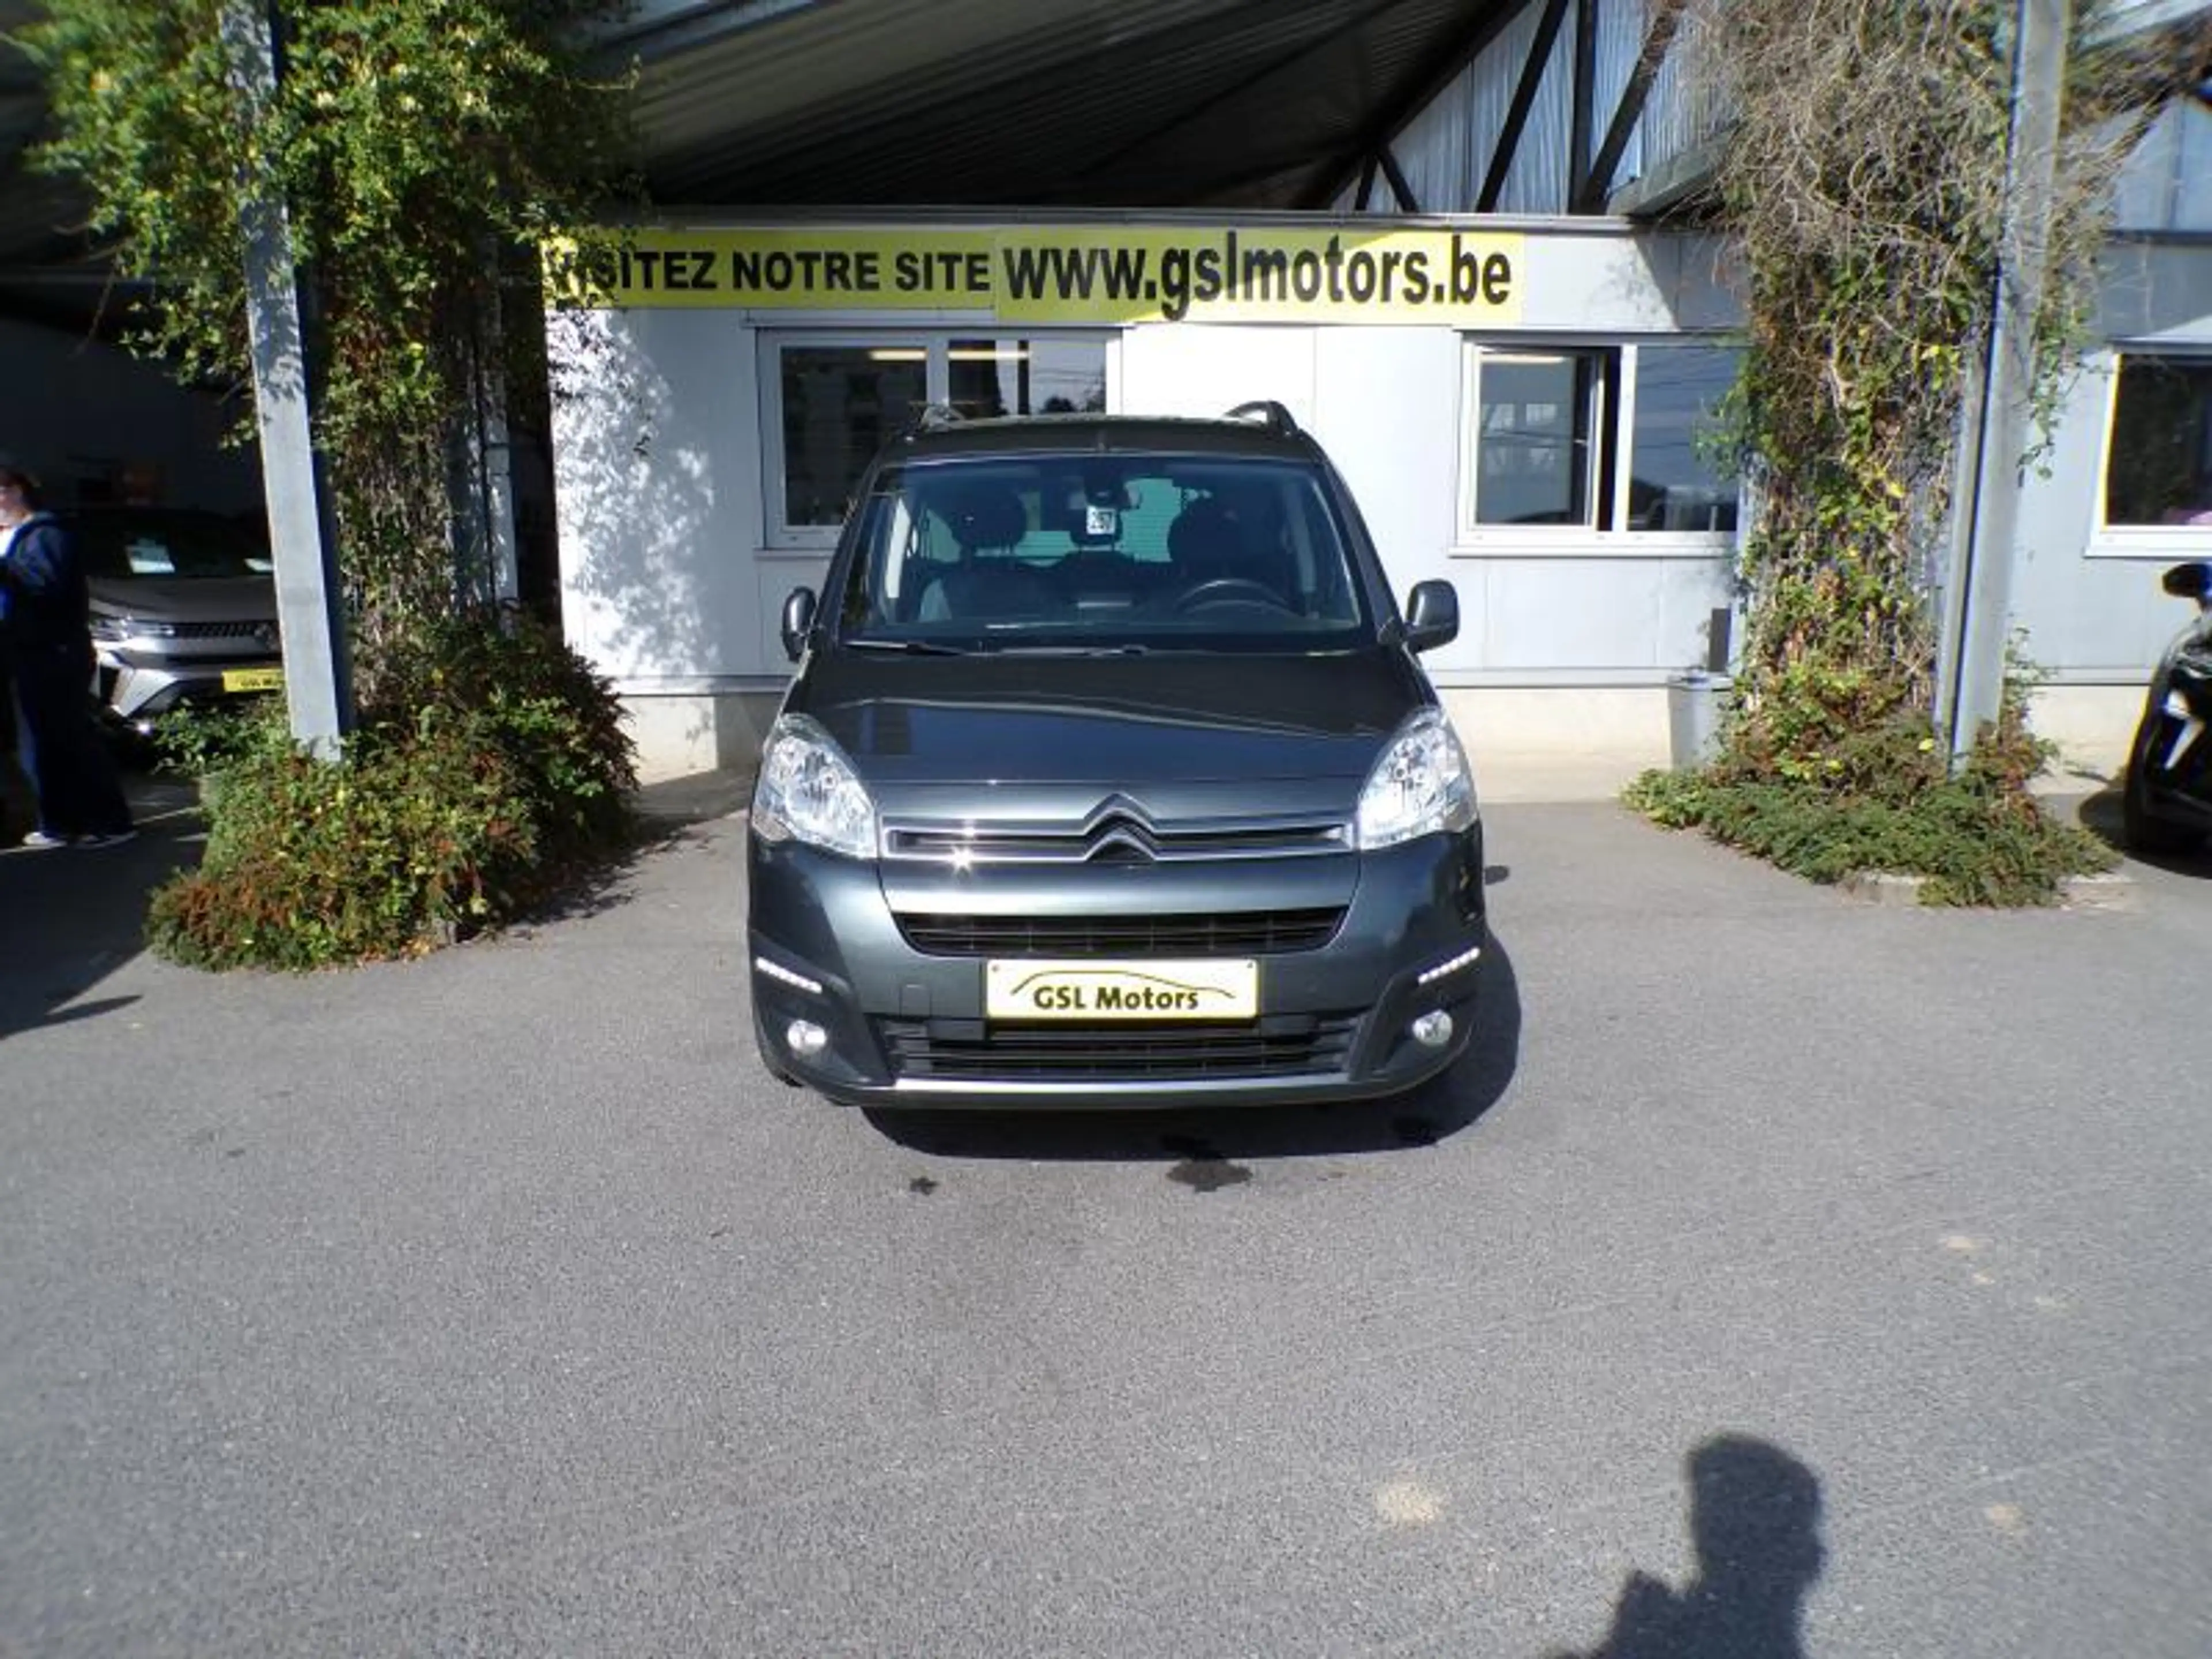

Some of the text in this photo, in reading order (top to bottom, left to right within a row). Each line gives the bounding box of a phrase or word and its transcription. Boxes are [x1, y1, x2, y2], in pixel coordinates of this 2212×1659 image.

[733, 251, 880, 290] NOTRE
[895, 251, 991, 291] SITE
[1002, 231, 1512, 321] www.gslmotors.be
[1034, 986, 1198, 1010] GSL Motors
